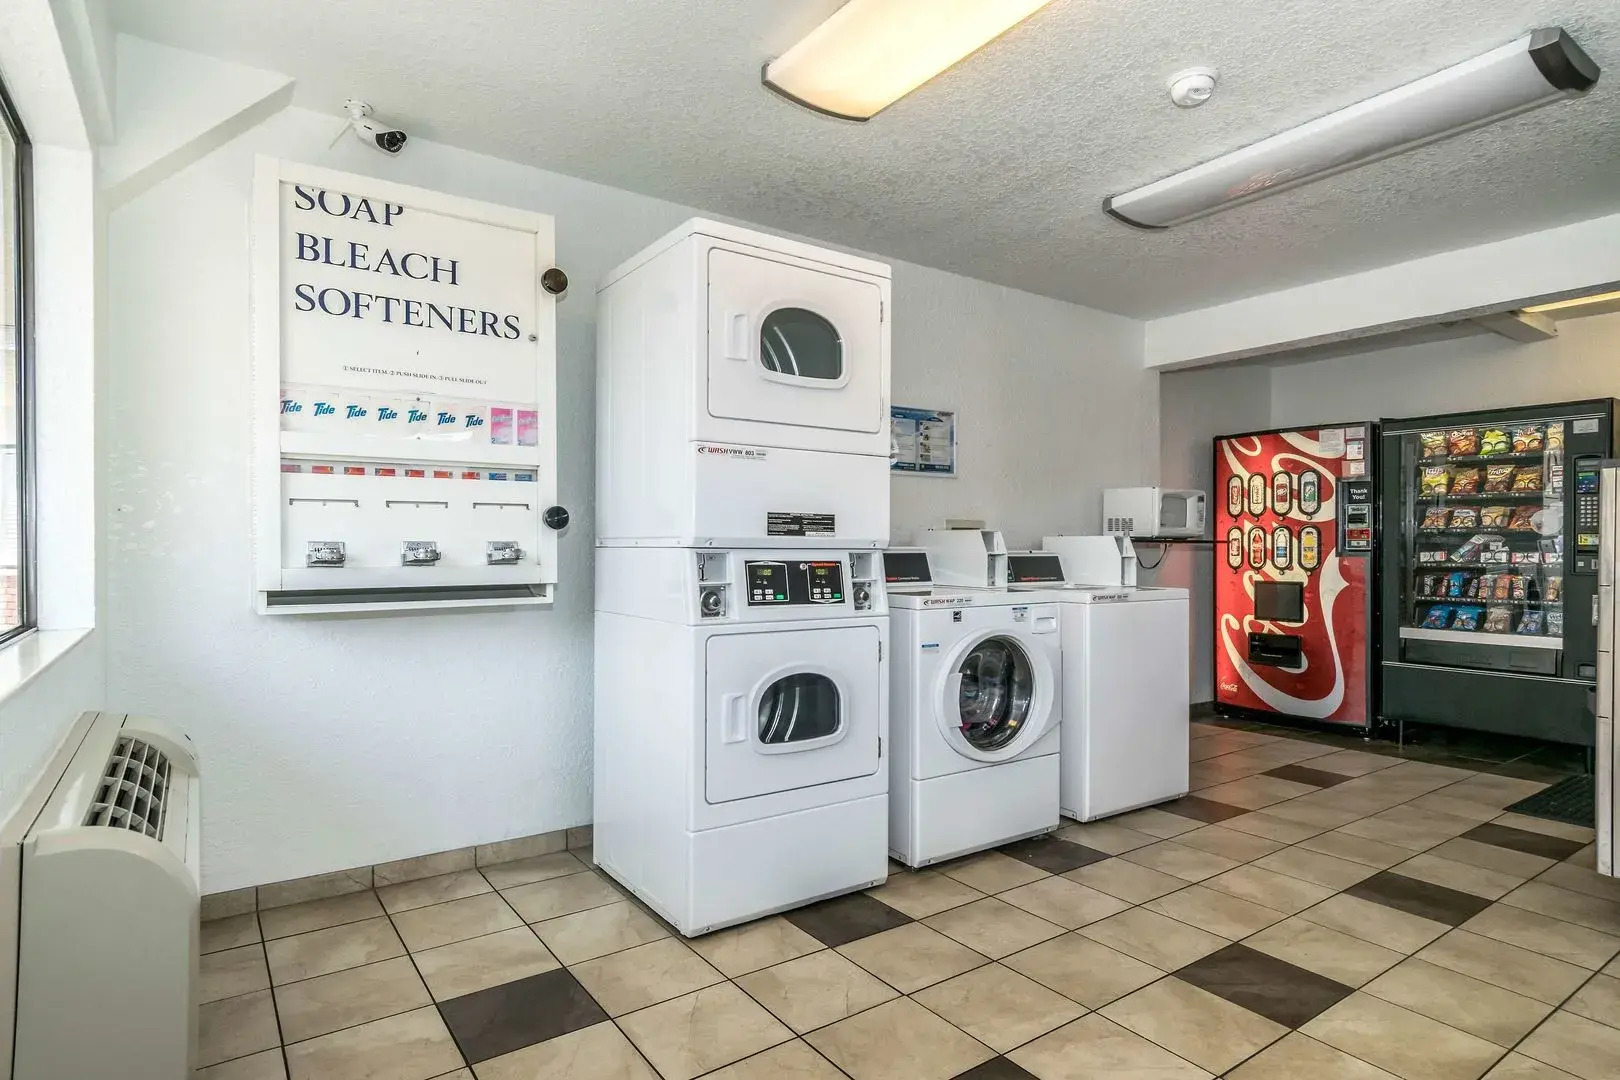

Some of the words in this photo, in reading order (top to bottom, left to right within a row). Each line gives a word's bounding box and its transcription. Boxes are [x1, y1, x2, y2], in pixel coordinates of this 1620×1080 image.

[294, 185, 404, 226] SOAP
[295, 231, 459, 285] BLEACH
[294, 283, 521, 340] SOFTENERS
[349, 365, 371, 373] SELECT
[280, 400, 302, 414] Tide
[313, 402, 335, 416] Tide
[346, 405, 367, 419] Tide
[378, 408, 398, 421] Tide
[408, 410, 427, 423] Tide
[437, 412, 456, 425] Tide
[465, 415, 484, 428] Tide
